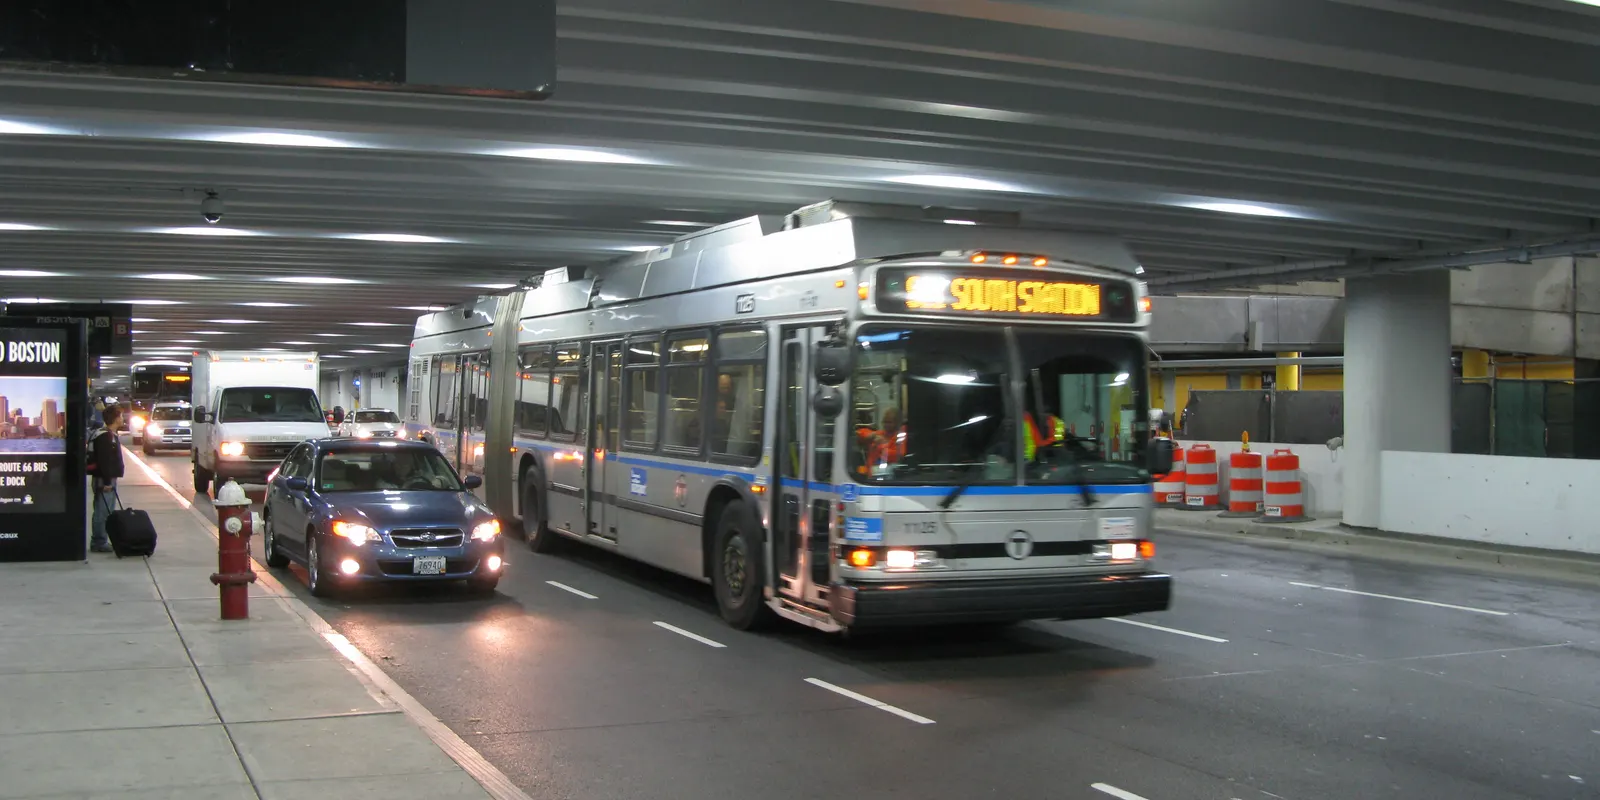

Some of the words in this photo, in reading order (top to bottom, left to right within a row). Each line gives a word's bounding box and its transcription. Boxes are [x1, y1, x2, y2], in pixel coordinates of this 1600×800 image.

[950, 278, 1017, 312] SOUTH
[1017, 281, 1100, 316] STATION
[116, 324, 128, 335] B
[9, 341, 60, 363] BOSTON
[0, 462, 22, 472] ROUTE
[22, 462, 32, 472] 66
[33, 462, 48, 472] BUS
[6, 476, 26, 487] DOCK
